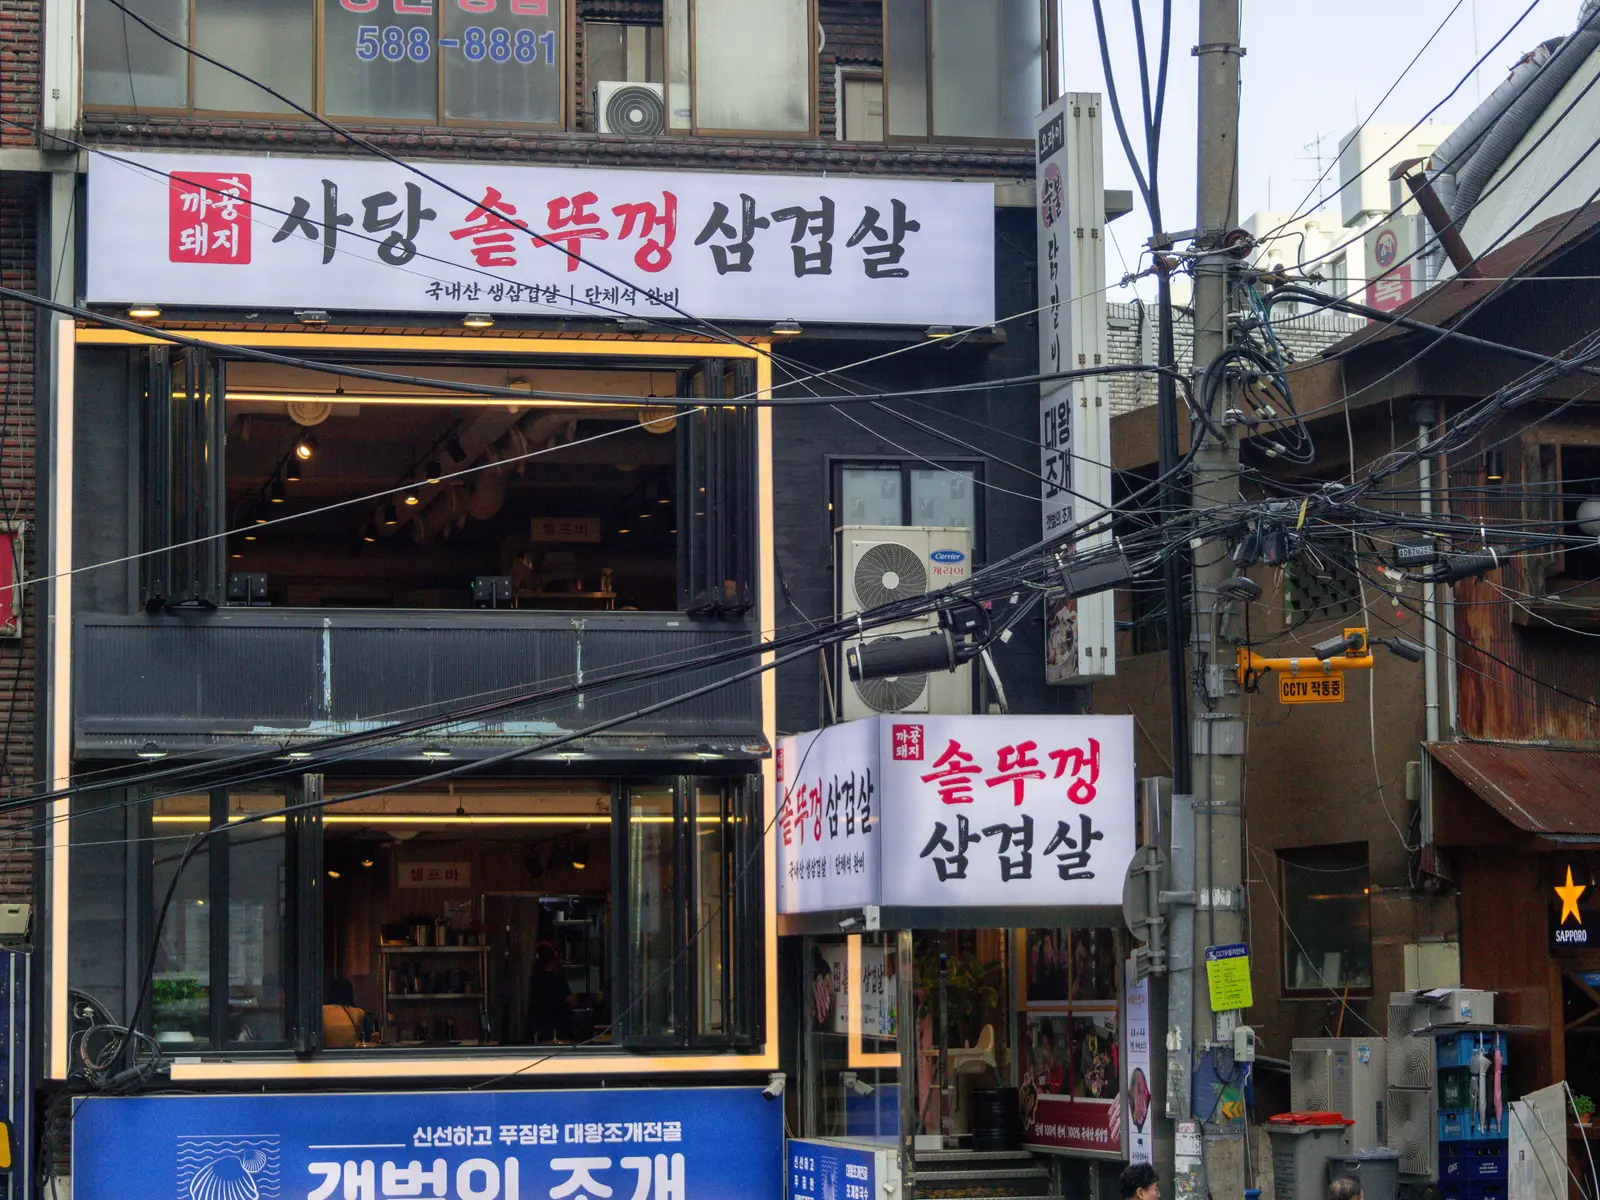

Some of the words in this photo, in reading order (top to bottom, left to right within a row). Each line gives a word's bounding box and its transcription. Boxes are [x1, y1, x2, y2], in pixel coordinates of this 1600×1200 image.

[355, 26, 555, 66] 588-8881
[1041, 120, 1062, 154] 오라이
[178, 221, 240, 258] 돼지
[272, 178, 437, 266] 사당
[449, 186, 679, 274] 솥뚜껑
[694, 193, 921, 279] 삼겹살
[425, 281, 481, 302] 국내산
[487, 283, 560, 304] 생삼겹살
[585, 285, 637, 307] 단체석
[645, 286, 680, 307] 완비
[1048, 232, 1060, 373] 닭갈비
[1044, 399, 1071, 451] 대왕
[1046, 447, 1072, 499] 조개
[1062, 506, 1073, 524] 조개
[932, 566, 965, 576] 캐리어
[934, 552, 961, 561] Carrier
[1283, 682, 1308, 696] CCTV
[1311, 681, 1340, 696] 작동중
[895, 743, 920, 759] 돼지
[920, 737, 1101, 806] 솥뚜껑
[778, 777, 823, 846] 솥뚜껑
[826, 767, 874, 839] 삼겹살
[919, 813, 1104, 882] 삼겹살
[1556, 930, 1587, 942] SAPPORO
[412, 1125, 492, 1148] 신선하고
[499, 1123, 559, 1146] 푸짐한
[564, 1121, 682, 1144] 대왕조개전골
